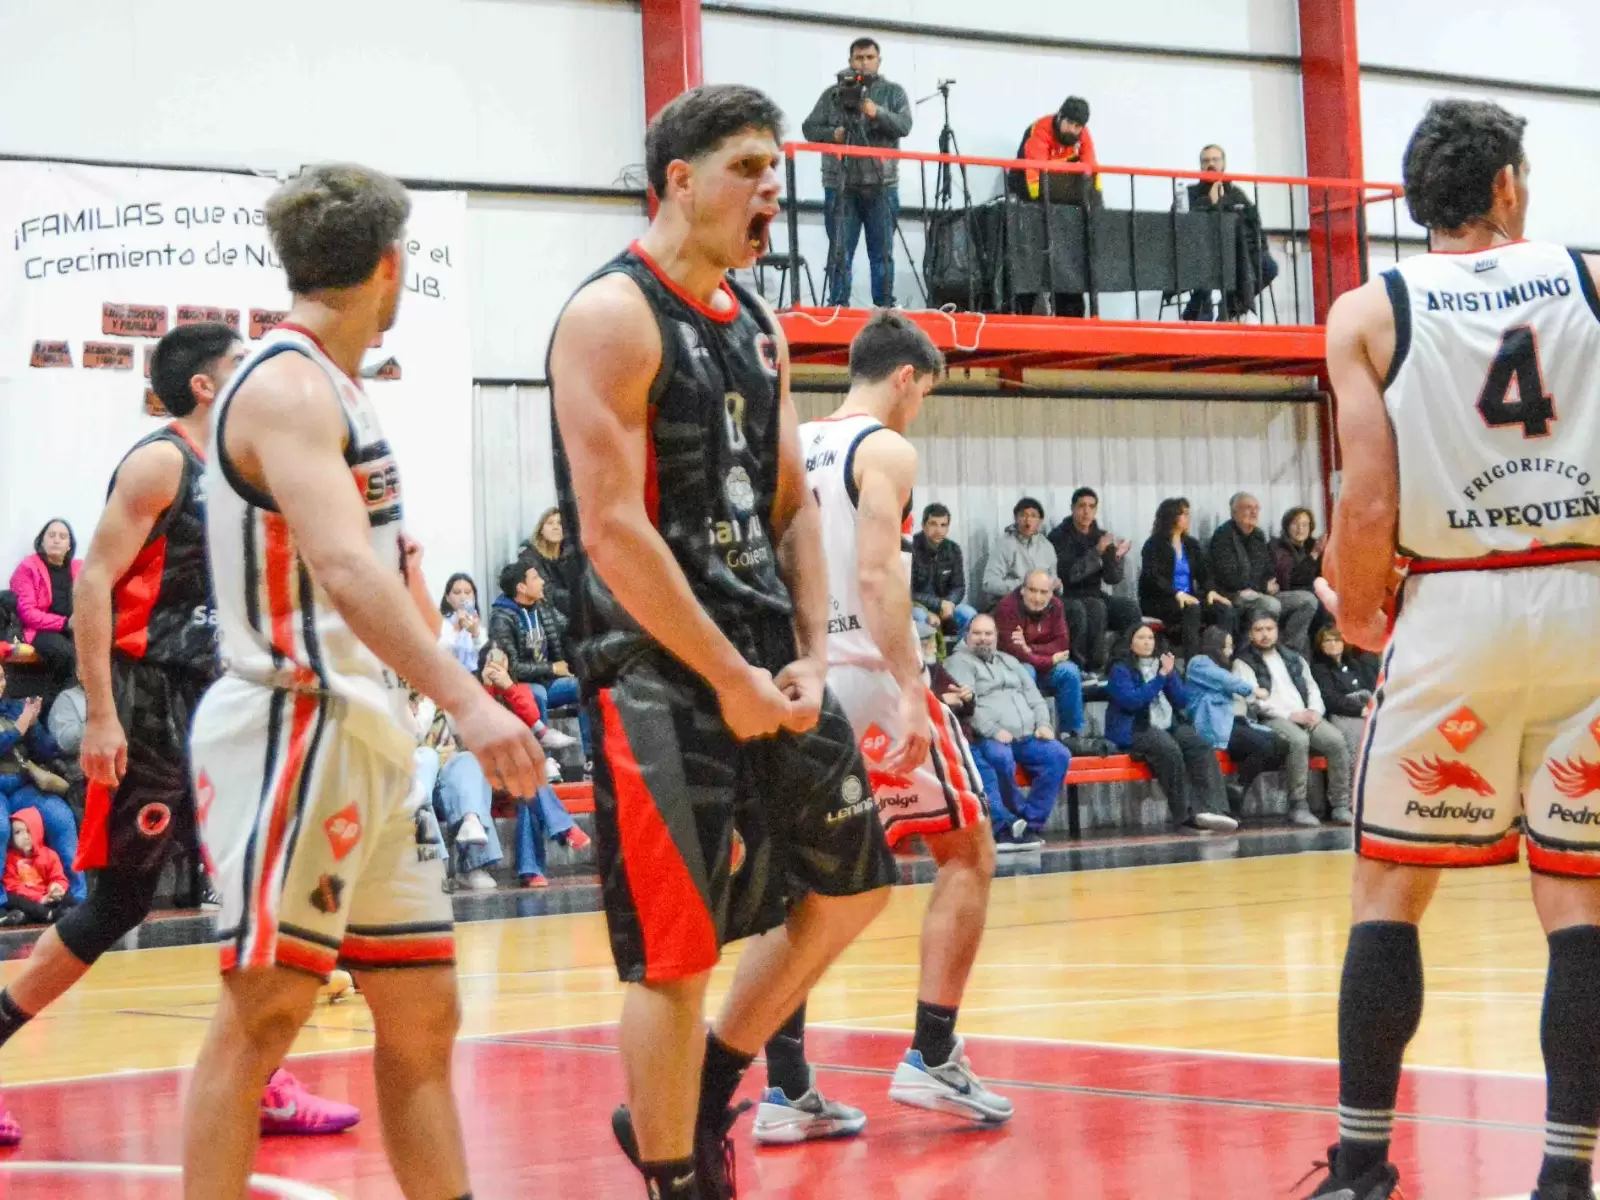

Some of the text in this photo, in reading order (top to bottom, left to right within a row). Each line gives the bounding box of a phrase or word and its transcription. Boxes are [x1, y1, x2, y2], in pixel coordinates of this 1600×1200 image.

[174, 206, 226, 229] que
[233, 207, 267, 226] na
[430, 245, 453, 268] el
[25, 243, 195, 280] Crecimiento
[205, 239, 238, 265] de
[245, 243, 282, 269] Nu
[1427, 274, 1571, 312] ARISTIMUÑO
[1474, 321, 1558, 440] 4
[1463, 457, 1591, 501] FRIGORIFICO
[1447, 491, 1600, 529] LA PEQUEÑ
[192, 605, 218, 625] Sa
[828, 613, 862, 634] EÑA
[1405, 799, 1495, 823] Pedrolga
